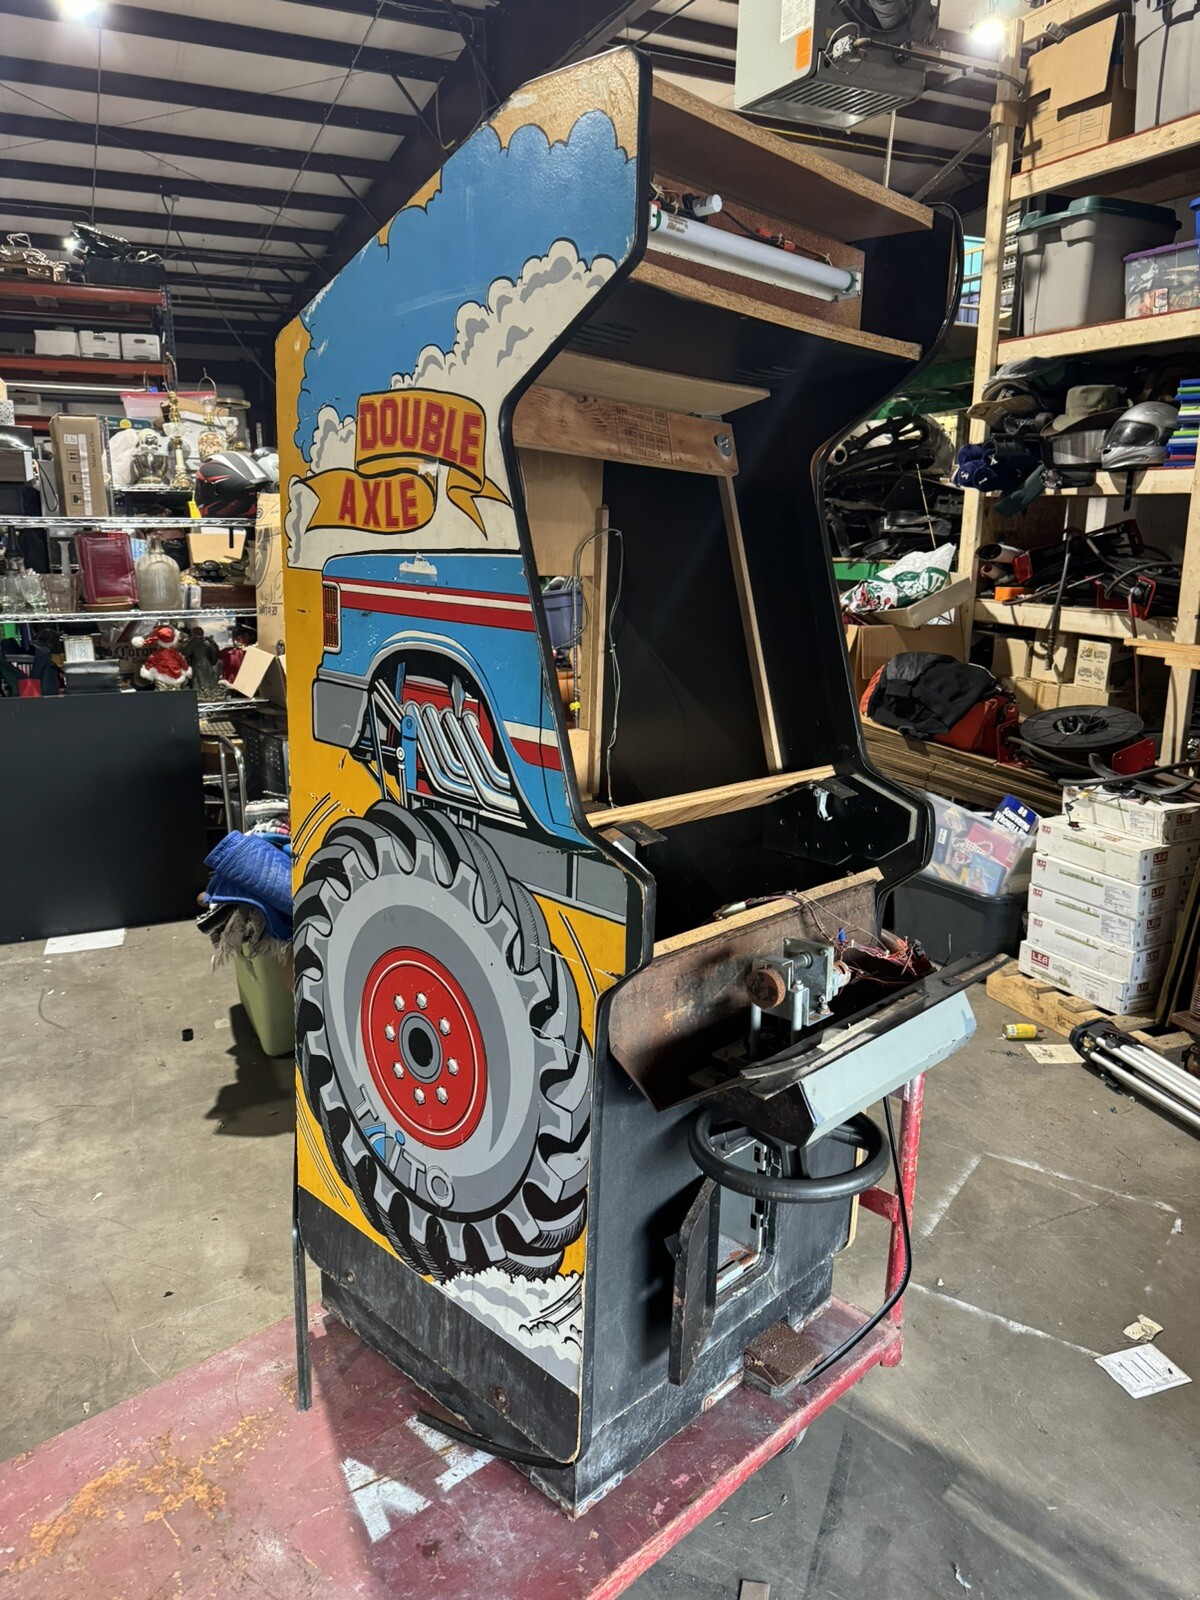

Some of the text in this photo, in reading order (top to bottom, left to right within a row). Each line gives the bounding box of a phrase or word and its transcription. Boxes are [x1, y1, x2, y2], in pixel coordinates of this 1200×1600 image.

[359, 396, 483, 469] DOUBLE
[338, 476, 419, 529] AXLE
[1154, 853, 1167, 862] LEA
[1032, 951, 1049, 965] LEA
